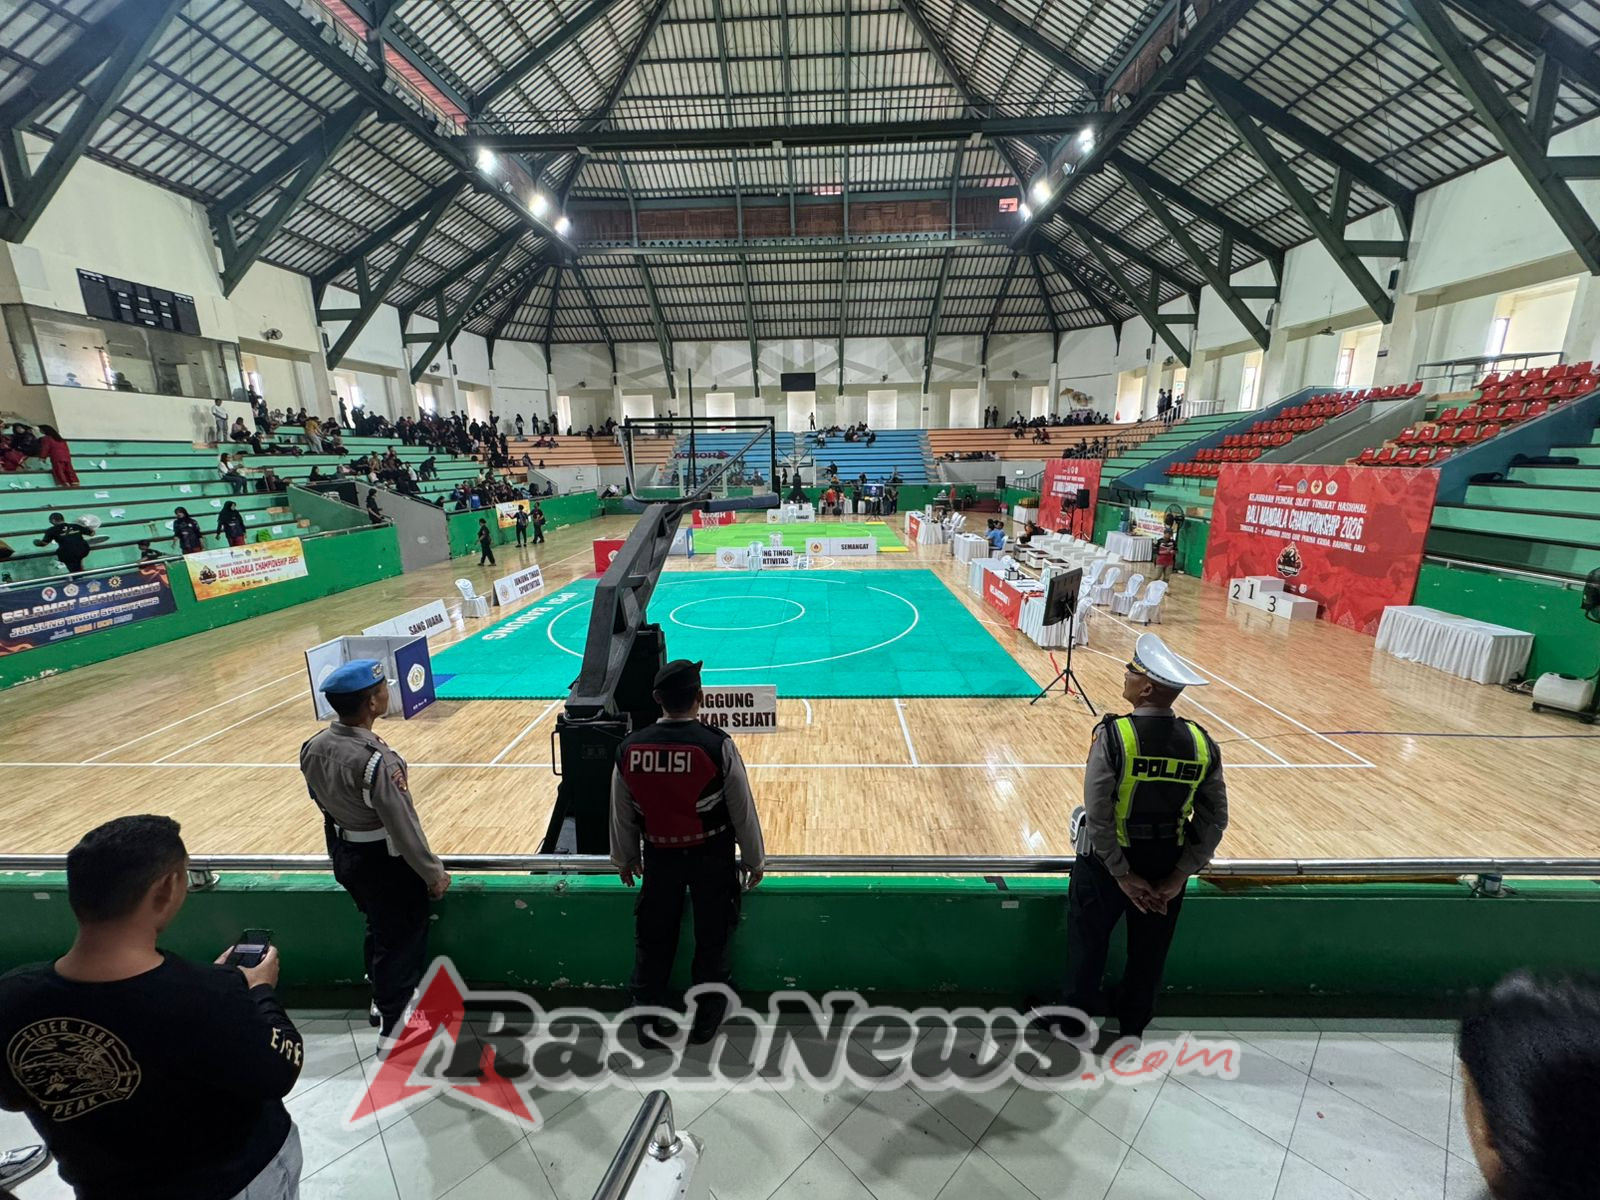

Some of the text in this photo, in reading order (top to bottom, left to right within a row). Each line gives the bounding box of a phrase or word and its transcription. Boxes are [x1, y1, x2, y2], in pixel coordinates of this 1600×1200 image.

[1296, 498, 1311, 508] SILAT
[1312, 500, 1337, 510] TINGKAT
[1338, 502, 1368, 514] NASIONAL
[1246, 506, 1364, 540] BALI MANDALA CHAMPIONSHIP 2026
[1354, 544, 1366, 554] BALI
[218, 569, 229, 579] BALI
[231, 564, 254, 575] MANDALA
[255, 558, 287, 571] CHAMPIONSHIP
[1, 582, 161, 624] SELAMAT BERTANDING
[1233, 584, 1276, 612] 2 1 3
[10, 618, 65, 638] JUNJUNG
[66, 609, 100, 627] TINGGI
[408, 613, 444, 635] SANG JUARA
[698, 712, 776, 727] KAR SEJATI
[629, 751, 691, 773] POLISI
[1131, 758, 1204, 781] POLISI
[22, 1021, 115, 1048] EIGER 1989
[52, 1096, 98, 1117] PEAK
